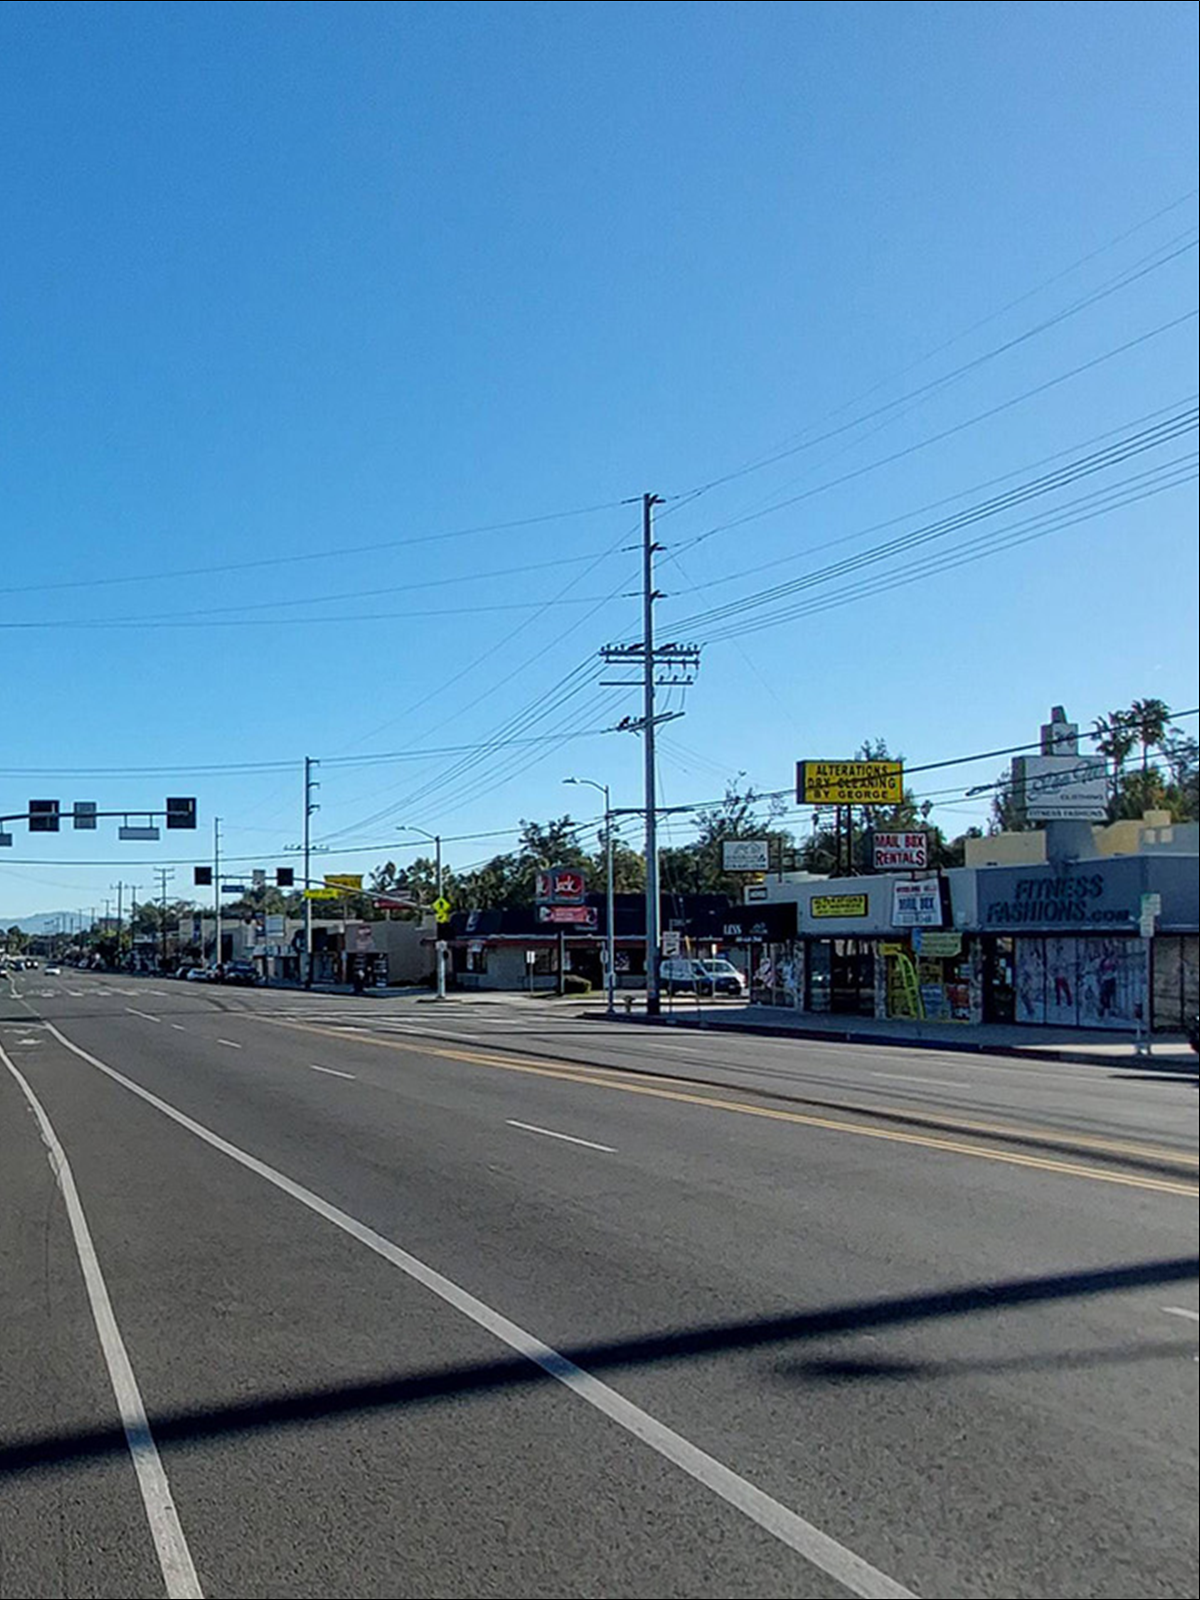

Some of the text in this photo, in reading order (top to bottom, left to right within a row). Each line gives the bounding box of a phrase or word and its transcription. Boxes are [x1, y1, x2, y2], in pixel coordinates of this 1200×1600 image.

[816, 765, 888, 776] ALTERATIONS
[807, 777, 896, 789] DRY CLEANING
[813, 790, 889, 799] BY GEORGE
[874, 834, 900, 848] MAIL
[874, 850, 926, 866] RENTALS
[1014, 873, 1104, 900] FITNESS
